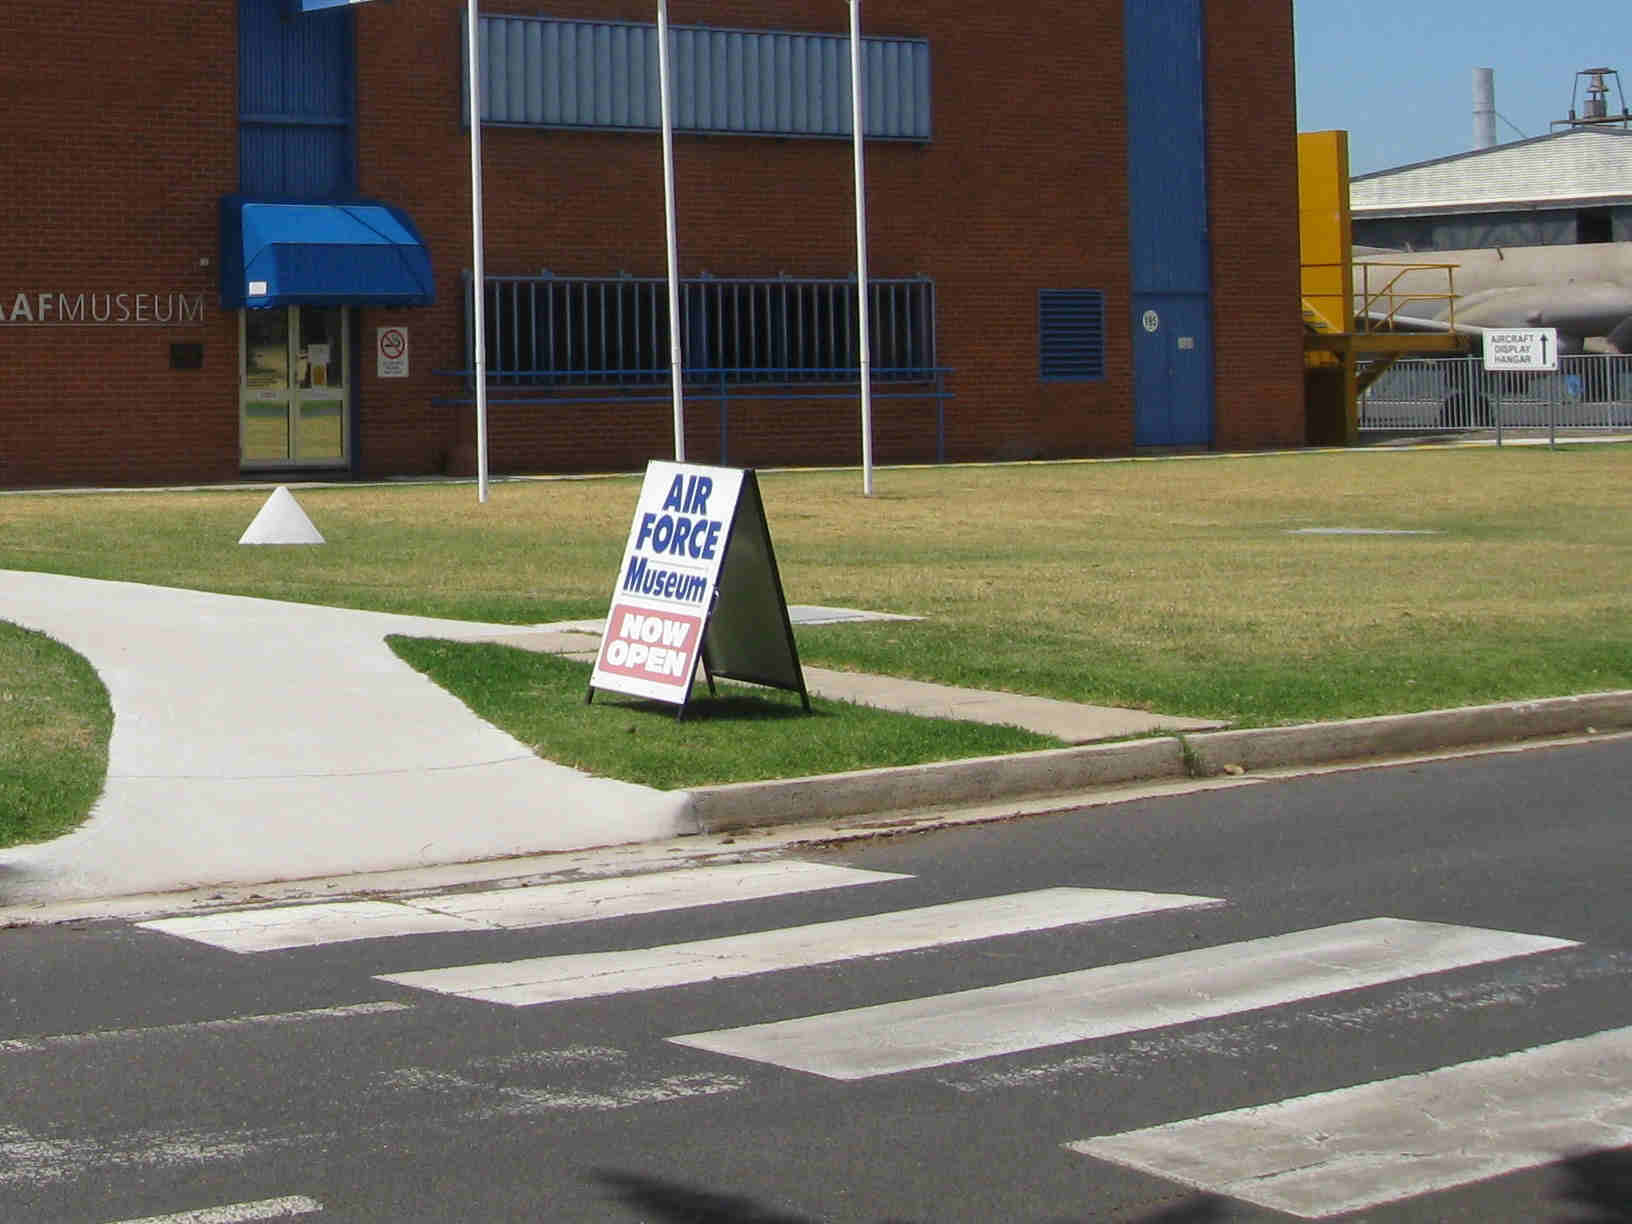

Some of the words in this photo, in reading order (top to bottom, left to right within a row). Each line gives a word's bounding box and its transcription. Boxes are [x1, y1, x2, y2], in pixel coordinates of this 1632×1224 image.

[1490, 334, 1535, 344] AIRCRAFT
[1494, 344, 1532, 353] DISPLAY
[1494, 354, 1532, 364] HANGAR
[662, 473, 713, 516] AIR
[635, 512, 722, 560] FORCE
[623, 555, 708, 603] Museum
[619, 613, 691, 647] NOW
[605, 639, 687, 677] OPEN
